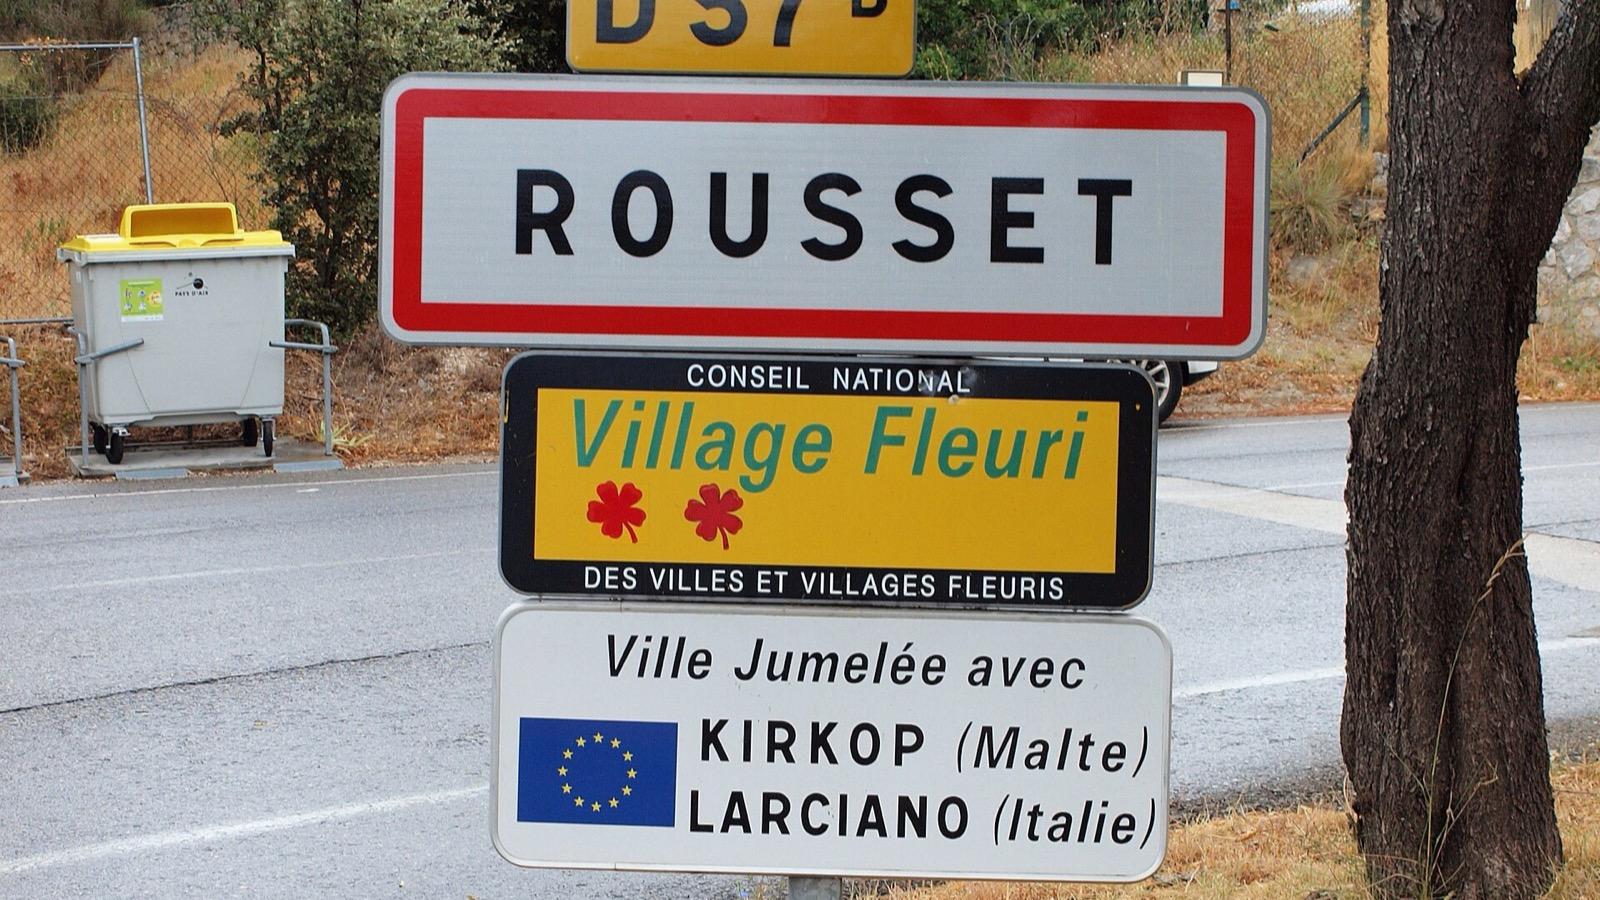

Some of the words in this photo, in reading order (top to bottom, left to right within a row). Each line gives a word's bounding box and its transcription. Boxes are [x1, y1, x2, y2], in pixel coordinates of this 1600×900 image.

[515, 168, 1133, 266] ROUSSET
[687, 363, 810, 390] CONSEIL
[833, 366, 971, 394] NATIONAL
[574, 399, 832, 493] Village
[864, 406, 1088, 478] Fleuri
[584, 566, 637, 590] DES
[649, 567, 744, 593] VILLES
[757, 570, 789, 594] ET
[800, 571, 935, 598] VILLAGES
[948, 575, 1064, 600] FLEURIS
[607, 634, 713, 680] Ville
[734, 638, 947, 686] Jumelée
[967, 655, 1086, 690] avec
[701, 718, 925, 767] KIRKOP
[957, 721, 1148, 778] (Malte)
[689, 789, 969, 840] LARCIANO
[994, 794, 1156, 850] (Italie)
